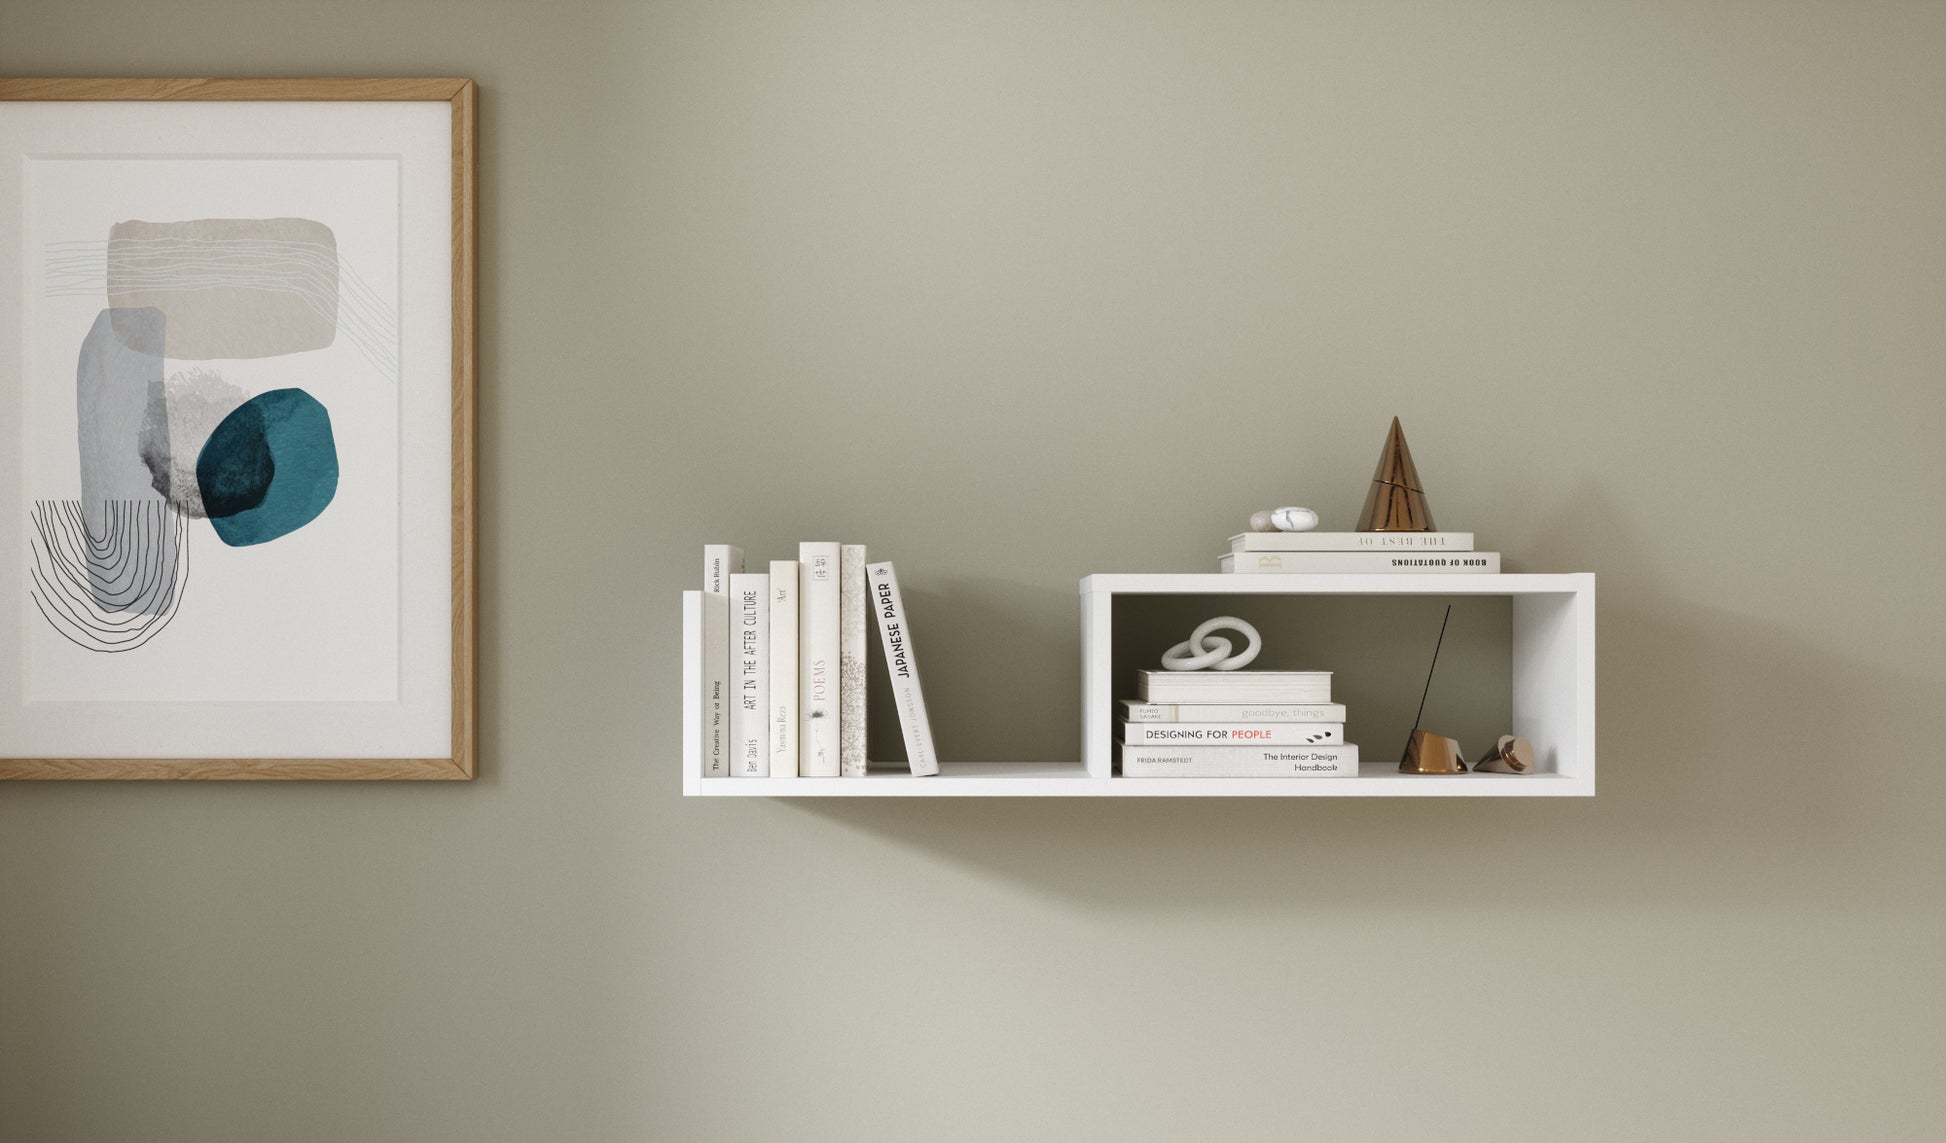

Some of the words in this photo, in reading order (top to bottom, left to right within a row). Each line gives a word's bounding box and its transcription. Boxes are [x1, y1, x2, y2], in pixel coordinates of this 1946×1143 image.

[1420, 537, 1447, 546] THE
[1391, 558, 1447, 566] QUOTATIONS
[1449, 558, 1460, 566] OF
[1463, 558, 1487, 566] BOOK
[743, 590, 757, 626] CULTURE
[877, 583, 896, 619] PAPER
[743, 630, 756, 656] AFTER
[887, 622, 910, 678] JAPANESE
[744, 660, 756, 675] THE
[743, 679, 756, 690] IN
[813, 659, 826, 702] POEMS
[713, 681, 721, 700] Being
[744, 694, 755, 710] ART
[712, 710, 721, 726] Way
[777, 705, 786, 722] Reza
[1241, 707, 1290, 719] goodbye,
[1292, 707, 1326, 719] things
[712, 728, 720, 755] Creative
[1145, 730, 1203, 740] DESIGNING
[1206, 730, 1228, 740] FOR
[1231, 730, 1272, 740] PEOPLE
[747, 739, 758, 755] Davis
[1157, 756, 1192, 764] RAMSTEDT
[1264, 753, 1279, 761] The
[1280, 753, 1309, 761] Interior
[1310, 753, 1339, 763] Design
[1294, 763, 1338, 772] Handbook
